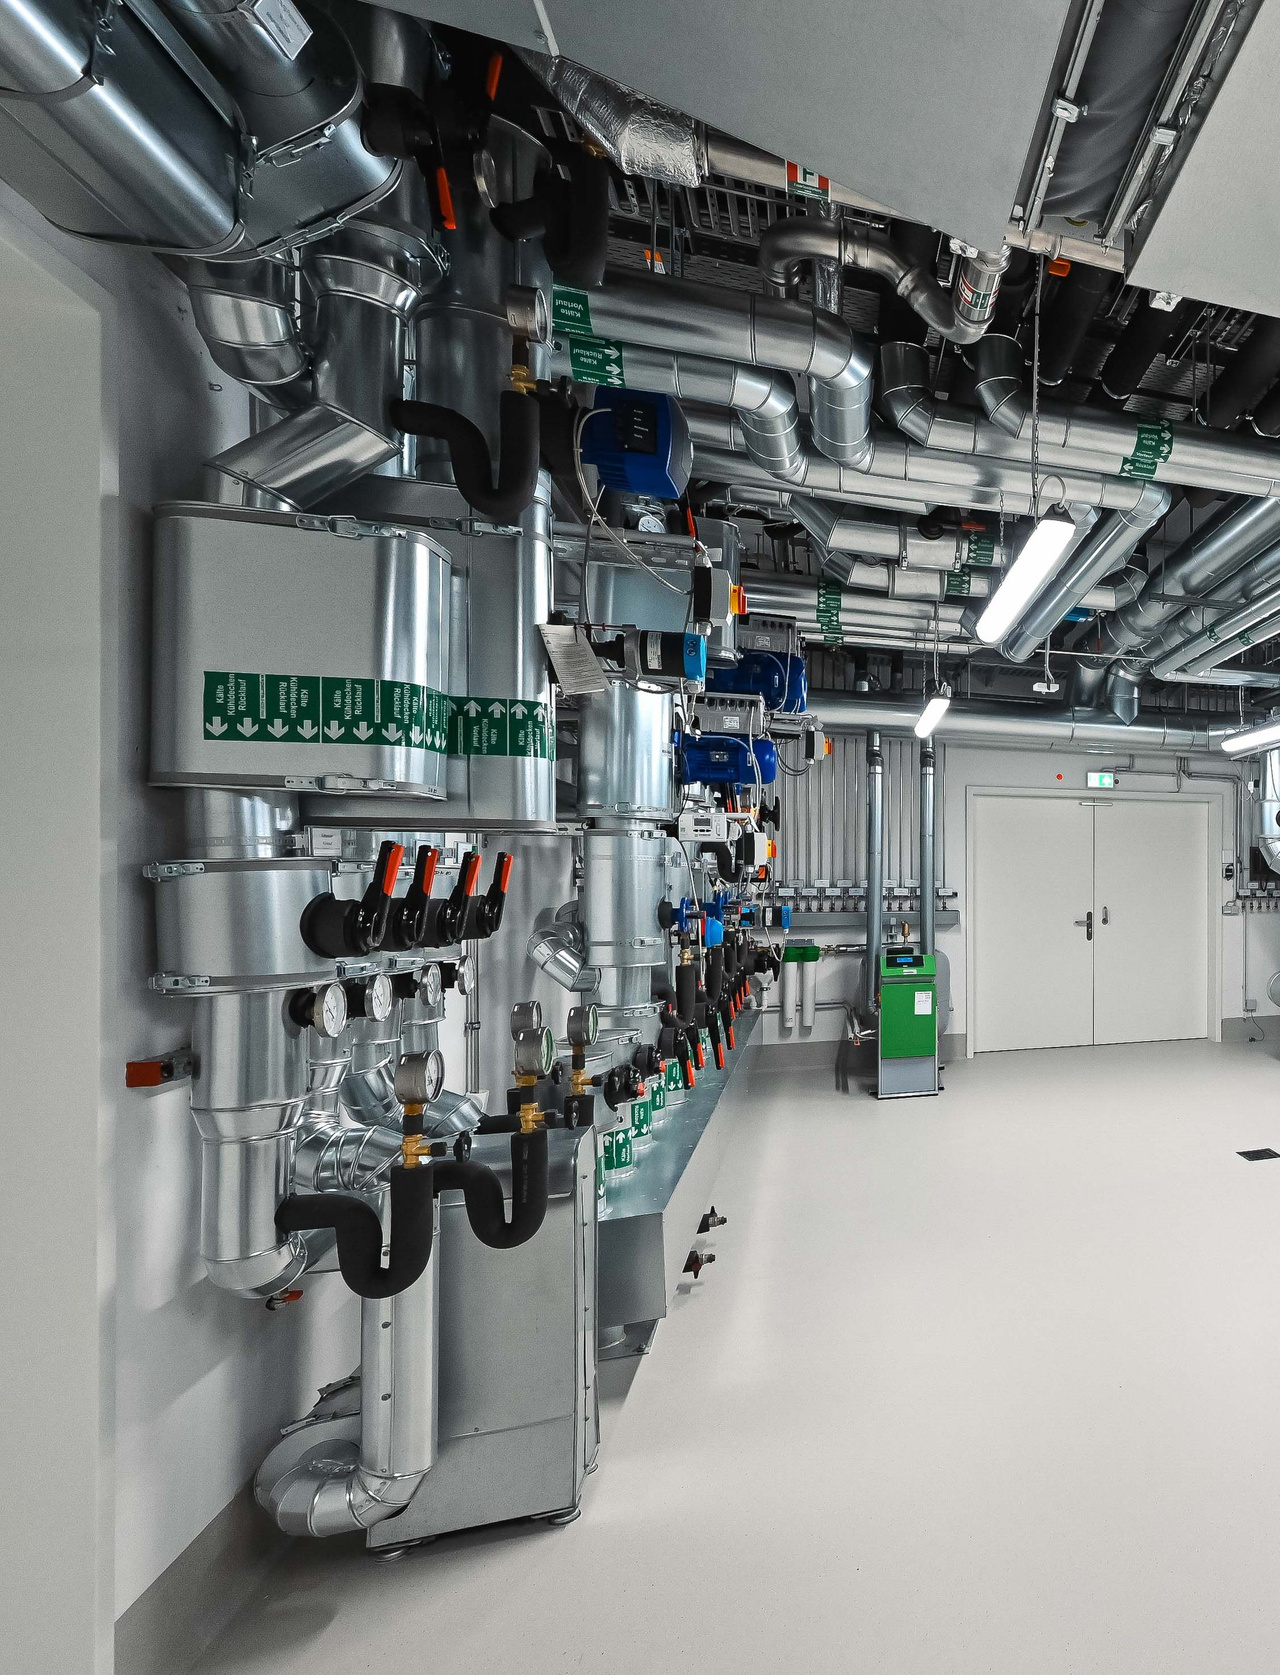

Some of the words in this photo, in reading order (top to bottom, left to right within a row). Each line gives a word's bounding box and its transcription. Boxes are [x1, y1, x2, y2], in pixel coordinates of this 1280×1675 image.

[555, 298, 584, 311] Vorlauf
[560, 308, 581, 318] Kälte
[573, 347, 603, 360] Rücklauf
[216, 684, 225, 704] Kälte
[227, 673, 236, 716] Kühldecken
[238, 678, 247, 711] Rücklauf
[279, 681, 287, 714] Rücklauf
[290, 676, 298, 719] Kühldecken
[300, 689, 309, 708] Kälte
[333, 689, 342, 708] Kälte
[344, 678, 352, 720] Kühldecken
[354, 684, 363, 715] Rücklauf
[393, 687, 402, 719] Rücklauf
[403, 684, 411, 724] Kühldecken
[481, 718, 489, 755] Kühldecken
[490, 728, 498, 745] Kälte
